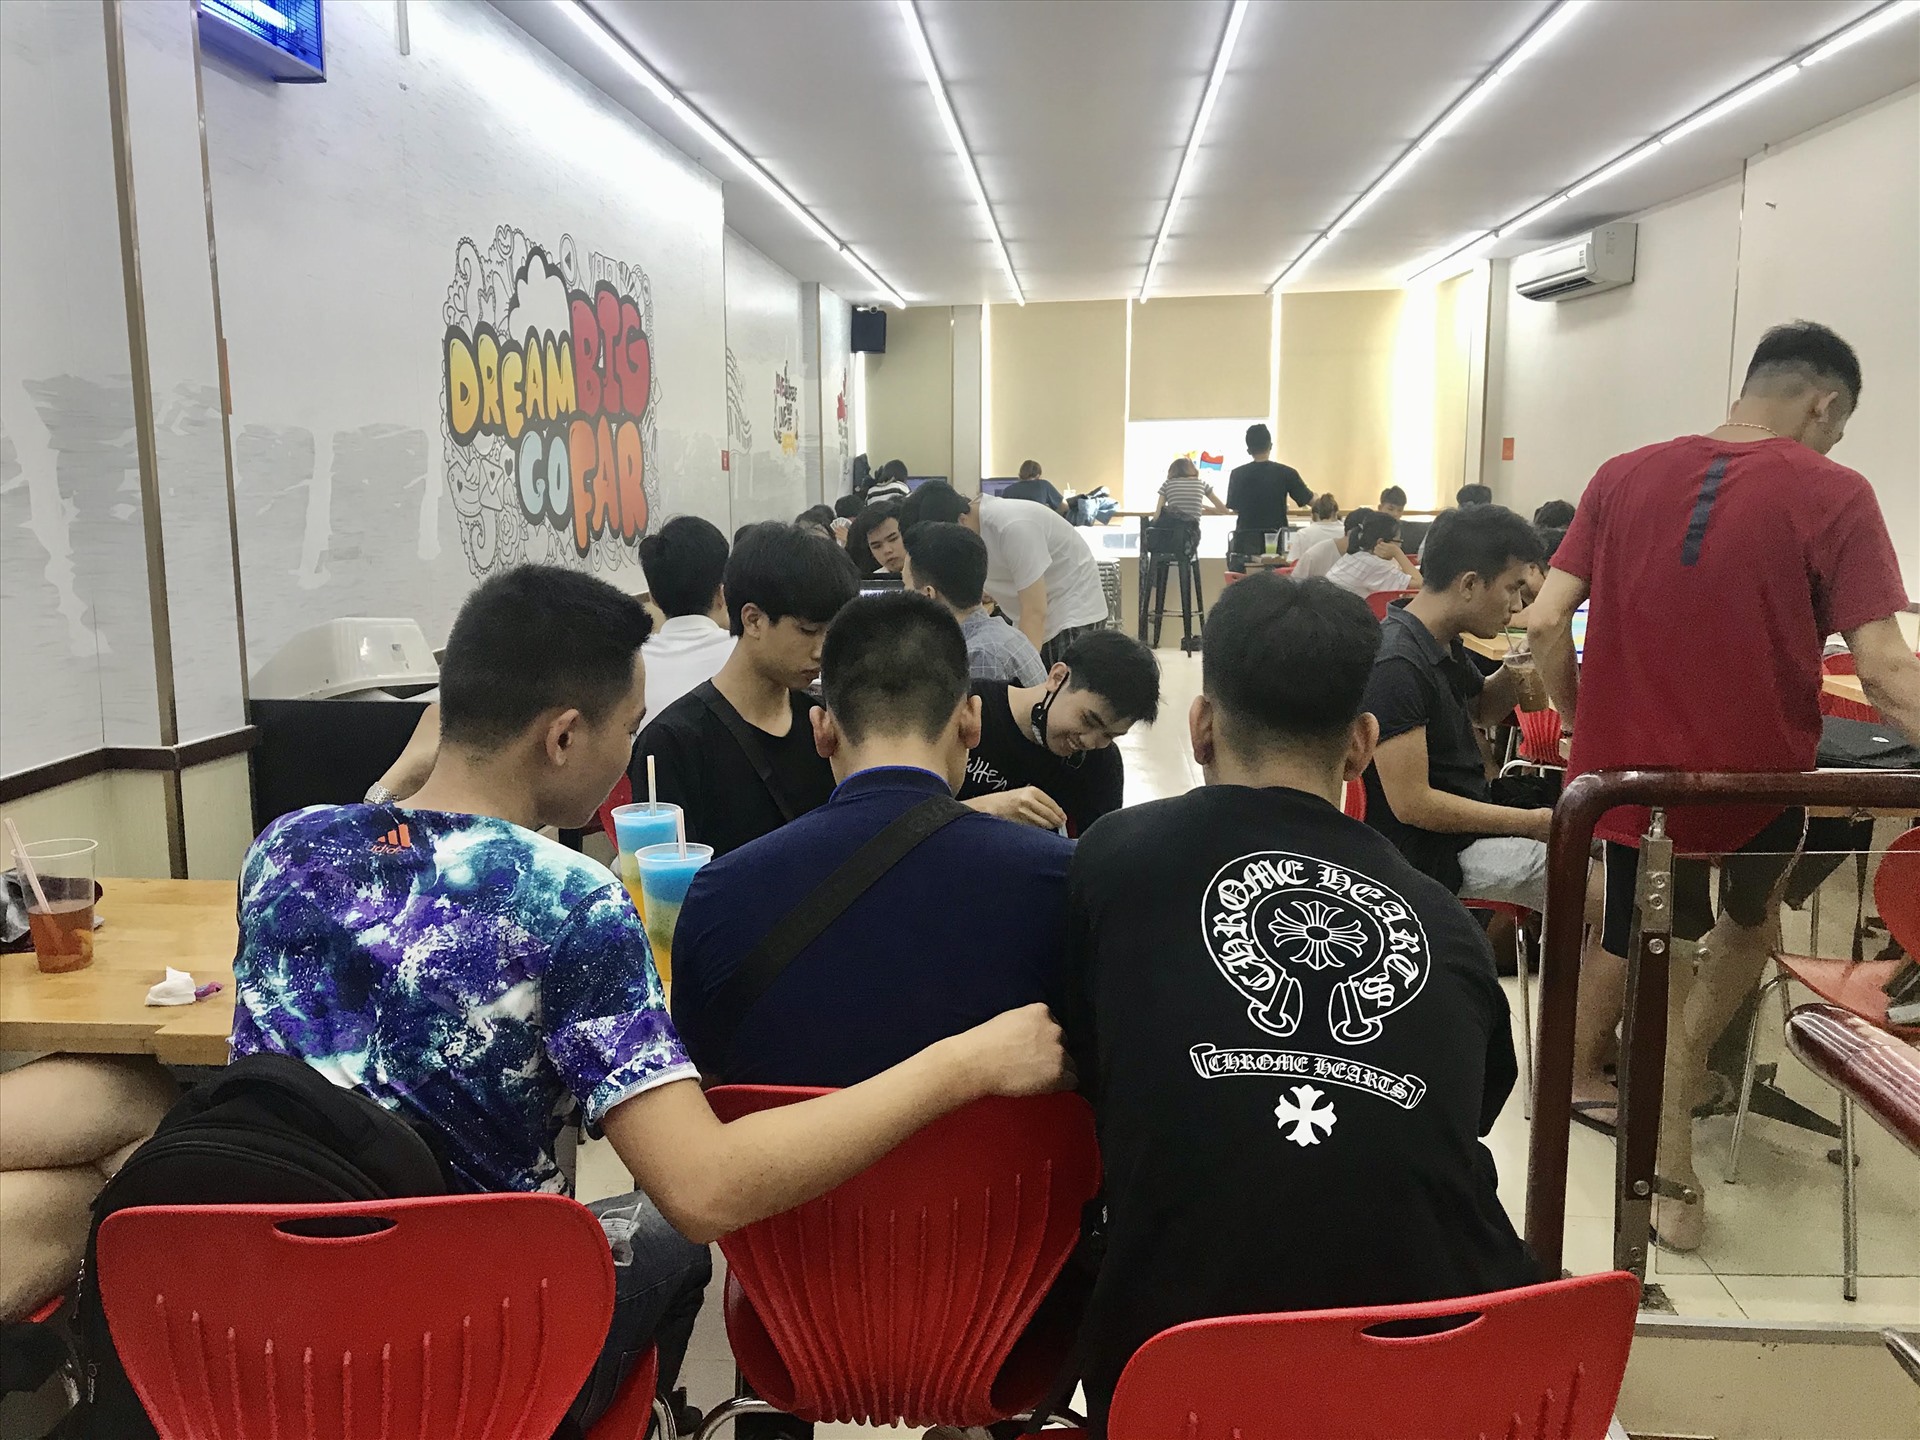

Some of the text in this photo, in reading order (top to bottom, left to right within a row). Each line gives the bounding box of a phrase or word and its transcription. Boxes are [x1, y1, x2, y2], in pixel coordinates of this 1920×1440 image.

[447, 328, 577, 443] DREAM
[569, 283, 650, 420] BIG
[517, 415, 649, 555] GO FAR
[1213, 859, 1421, 1008] CHROME HEARTS
[1208, 1053, 1408, 1099] CHROME HEARTS
